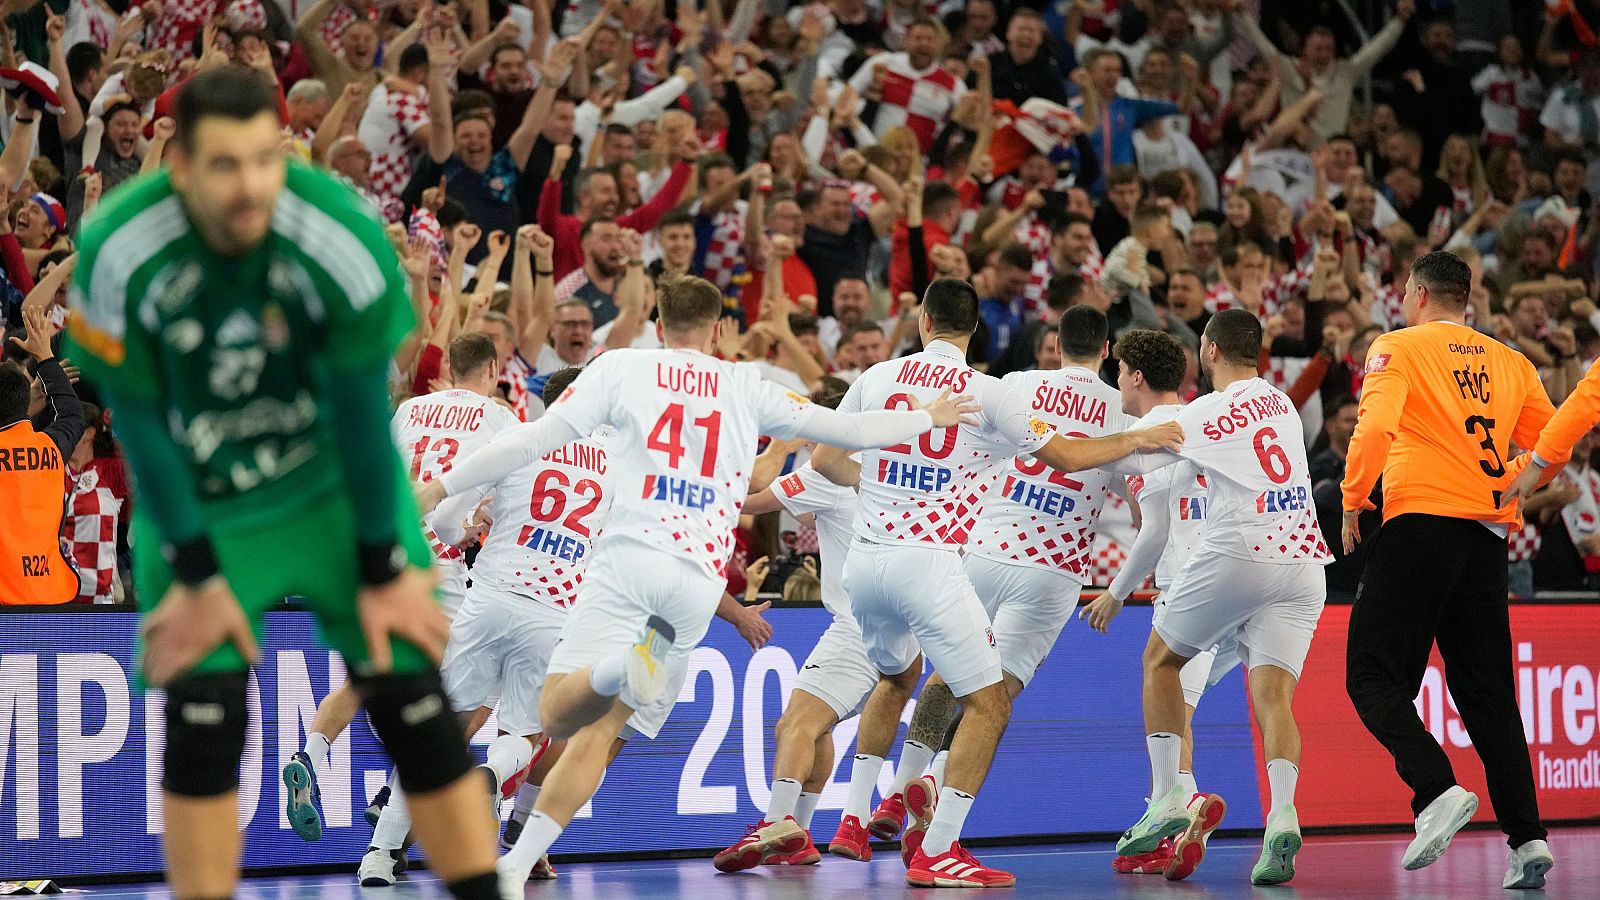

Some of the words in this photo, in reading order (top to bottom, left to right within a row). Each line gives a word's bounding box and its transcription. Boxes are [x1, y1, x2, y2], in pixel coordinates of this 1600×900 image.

[657, 362, 719, 398] LUČIN
[896, 359, 976, 394] MARAŠ
[1065, 374, 1093, 384] CROATIA
[404, 402, 486, 432] PAVLOVIĆ
[1031, 380, 1107, 428] ŠUŠNJA
[647, 402, 722, 478] 41
[1252, 426, 1292, 485] 6
[0, 447, 59, 472] REDAR
[408, 435, 460, 484] 13
[670, 477, 716, 512] HEP
[900, 463, 952, 492] HEP
[529, 469, 603, 539] 62
[1024, 484, 1076, 519] HEP
[540, 530, 585, 565] HEP
[676, 645, 926, 815] 202
